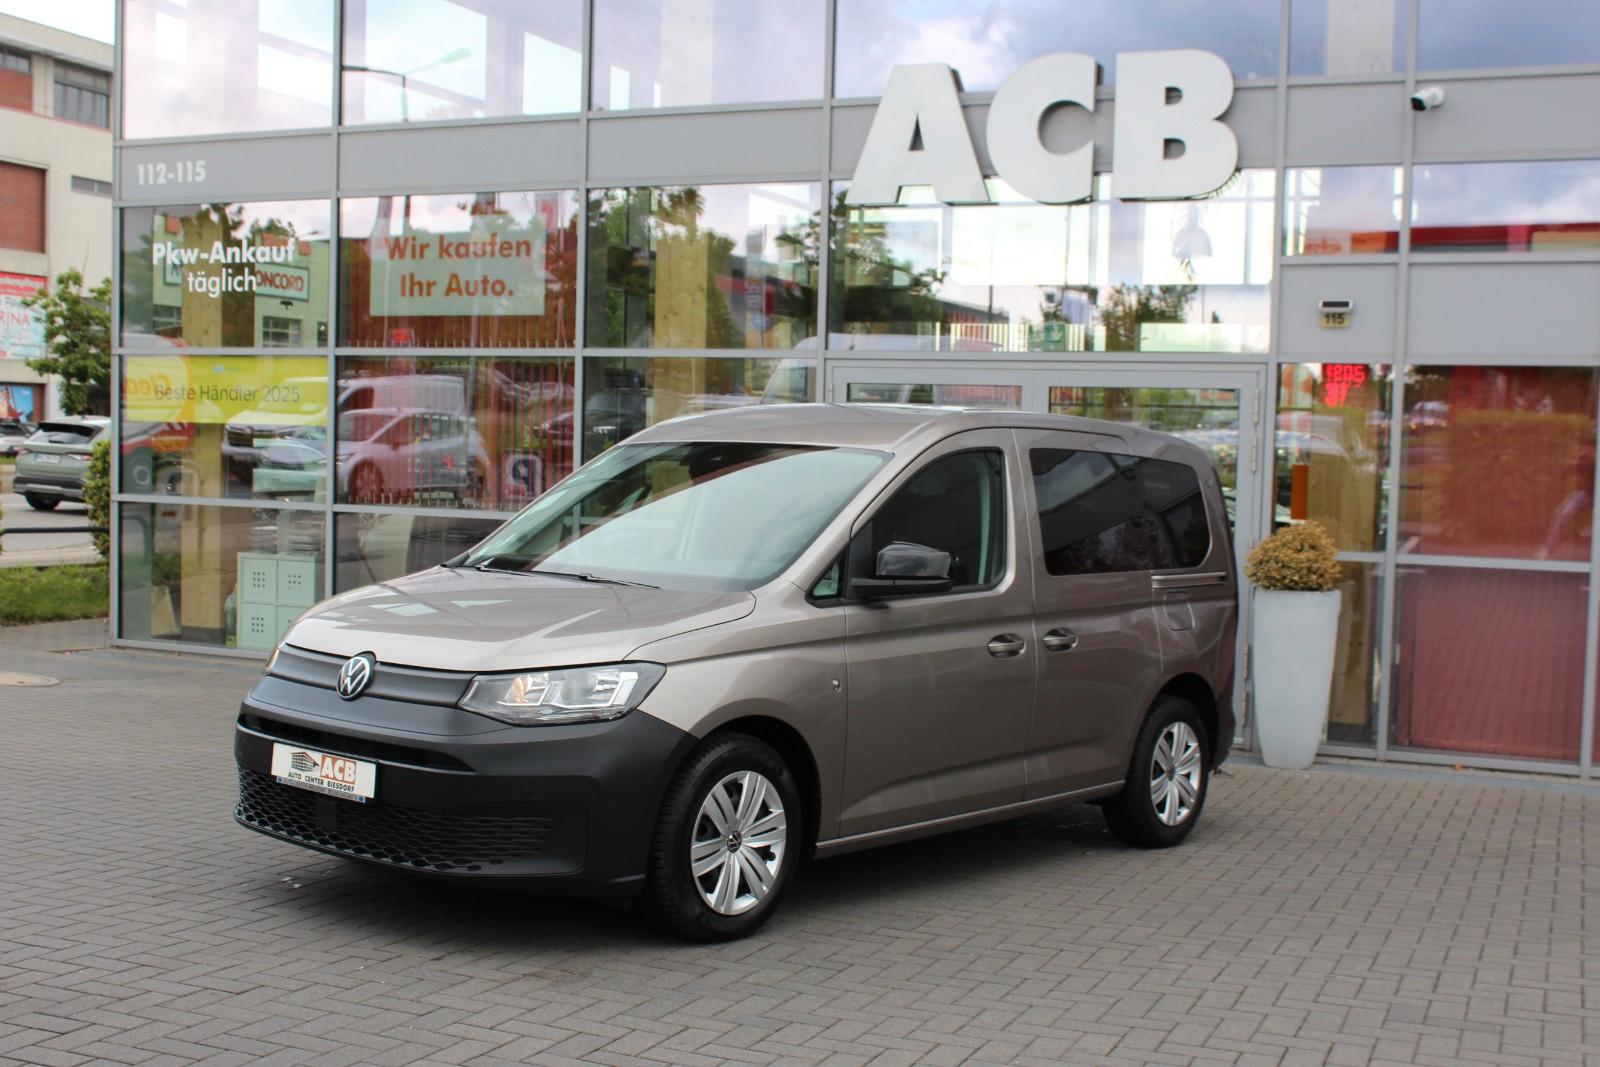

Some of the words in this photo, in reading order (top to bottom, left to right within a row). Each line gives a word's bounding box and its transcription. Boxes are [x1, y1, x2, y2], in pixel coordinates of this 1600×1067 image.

[846, 49, 1239, 205] ACB
[137, 160, 206, 186] 112-115
[152, 239, 296, 265] Pkw-Ankauf
[384, 236, 430, 260] Wir
[438, 232, 531, 260] kaufen
[187, 267, 257, 298] täglich
[254, 270, 304, 292] ONCORD
[400, 272, 437, 297] Ihr
[444, 273, 514, 297] Auto.
[1325, 312, 1345, 325] 115
[154, 384, 196, 401] Beste
[199, 384, 258, 402] Händler
[263, 386, 300, 403] 2025
[321, 756, 356, 781] ACB
[288, 771, 302, 780] AUTO
[304, 775, 324, 786] CENTER
[327, 780, 355, 792] BIESDORF
